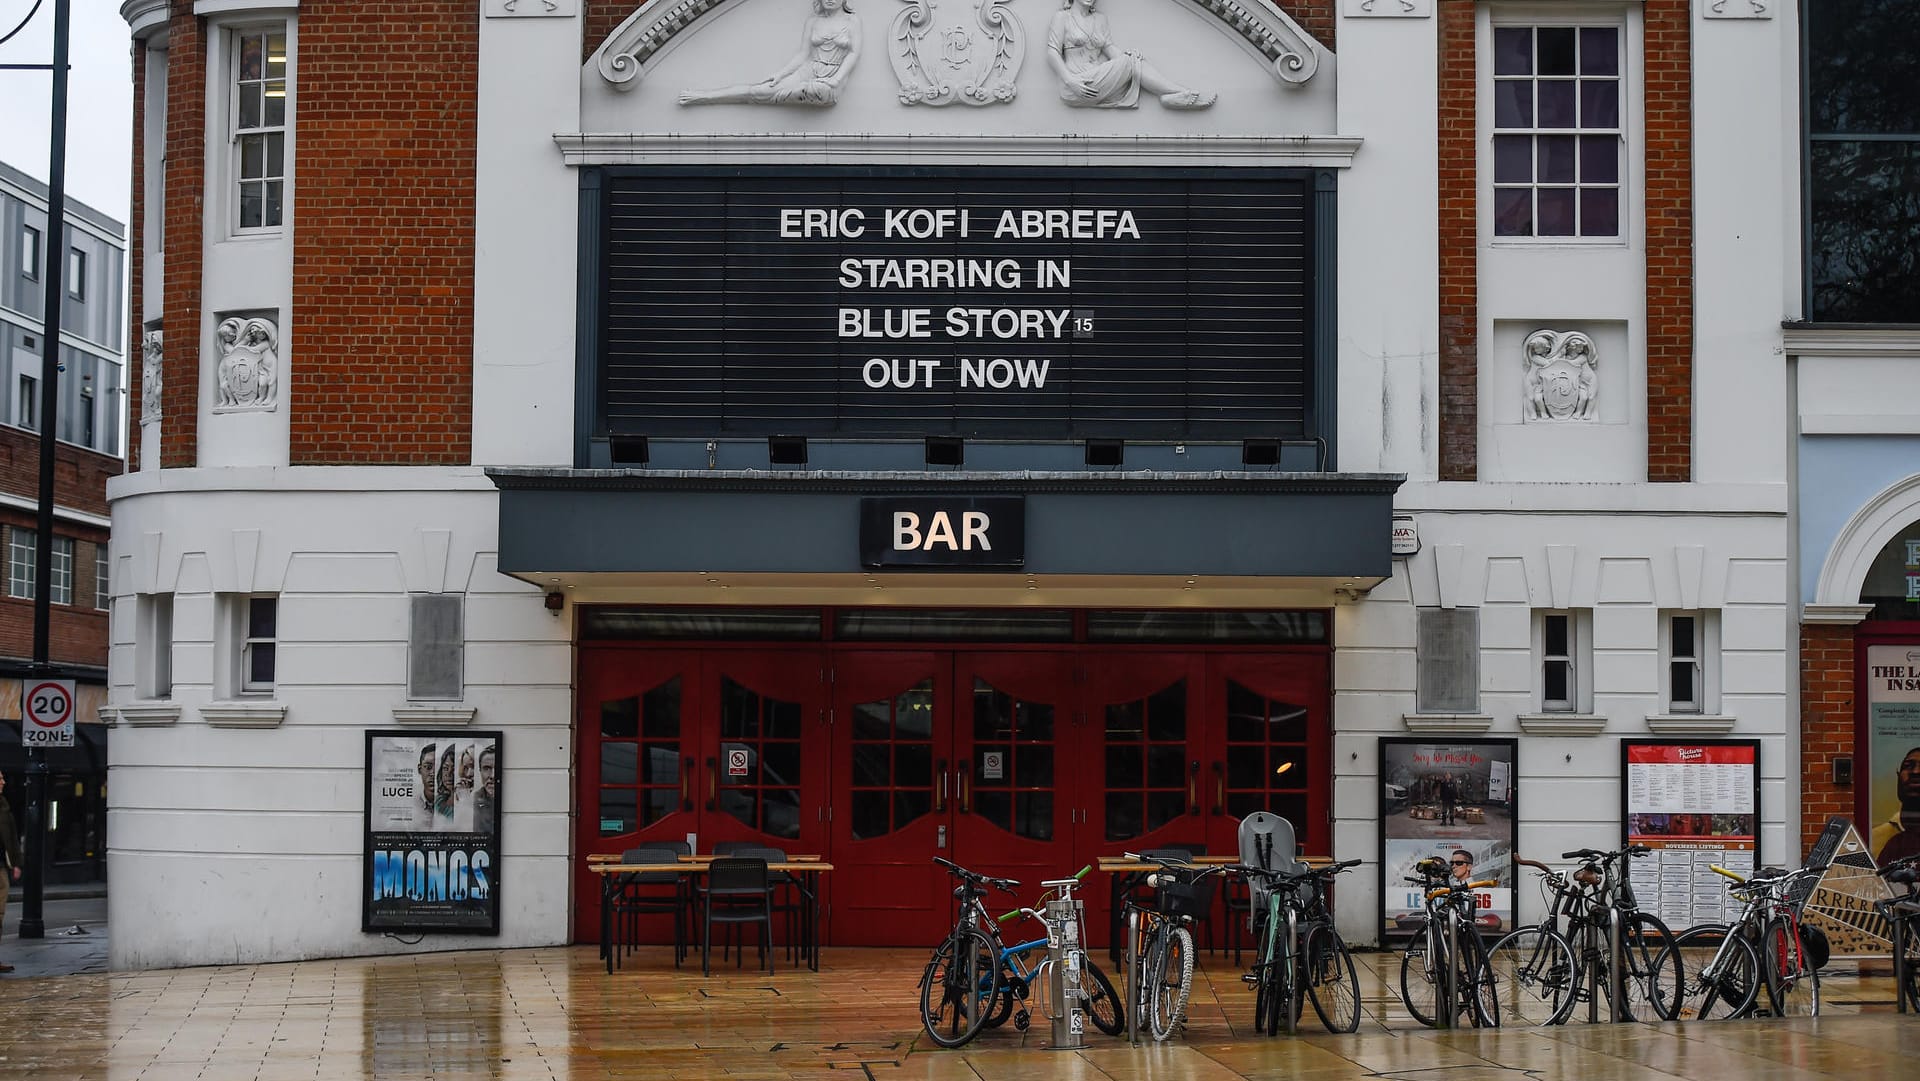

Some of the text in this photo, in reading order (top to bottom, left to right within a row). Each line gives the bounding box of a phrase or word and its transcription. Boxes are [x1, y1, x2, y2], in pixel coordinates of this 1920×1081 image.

[780, 208, 1141, 239] ERIC KOFI ABREFA
[838, 258, 1070, 289] STARRING IN
[838, 307, 1093, 339] BLUE STORY 15
[862, 358, 1050, 389] OUT NOW
[893, 511, 992, 551] BAR
[1872, 666, 1904, 678] THE
[1888, 679, 1902, 691] IN
[34, 696, 65, 714] 20
[28, 730, 70, 742] ZONE
[382, 787, 413, 797] LUCE
[373, 849, 490, 902] MONOS
[1406, 893, 1421, 909] LE
